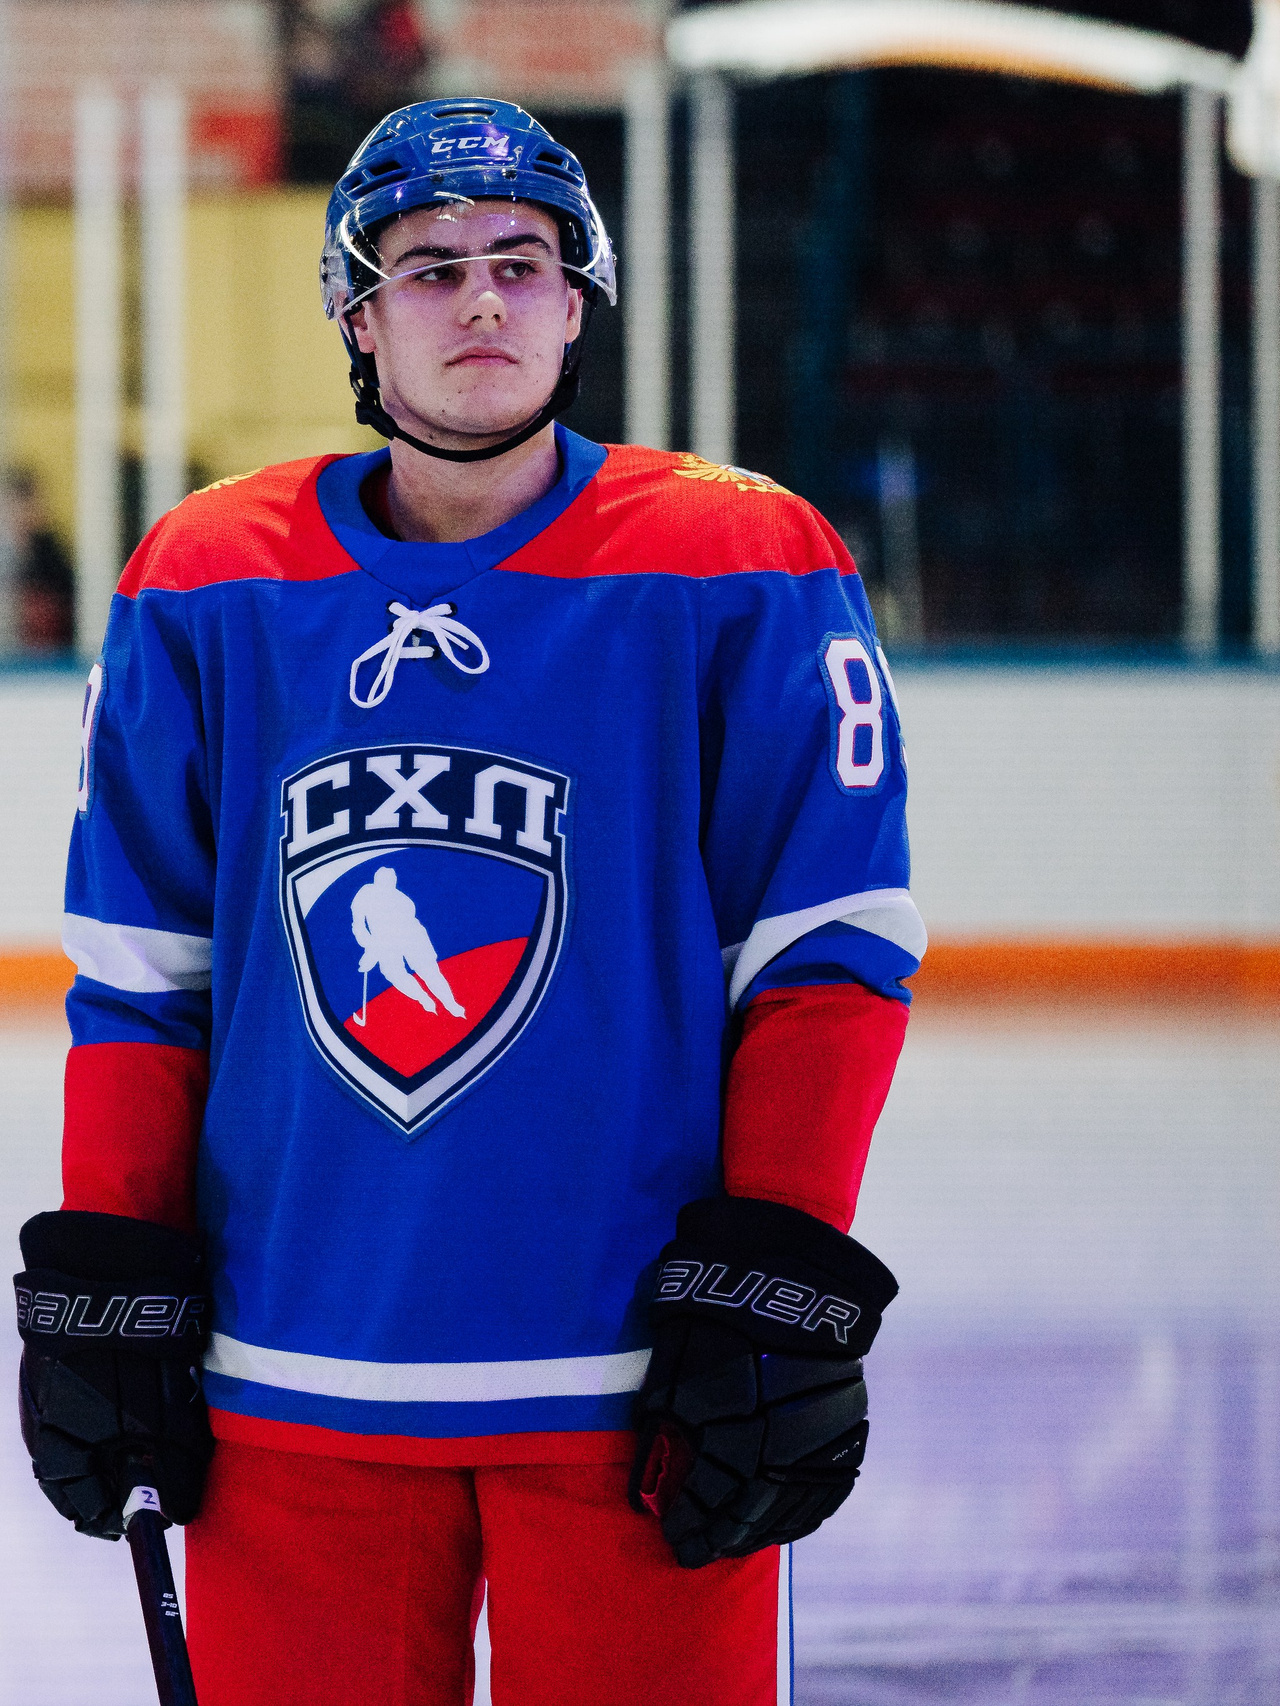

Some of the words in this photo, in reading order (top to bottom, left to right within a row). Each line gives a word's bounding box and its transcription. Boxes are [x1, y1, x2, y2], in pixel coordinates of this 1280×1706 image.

[431, 134, 510, 154] CCM
[825, 640, 909, 788] 8
[287, 754, 555, 857] СХП
[654, 1260, 861, 1345] AUER
[141, 1489, 157, 1505] 2
